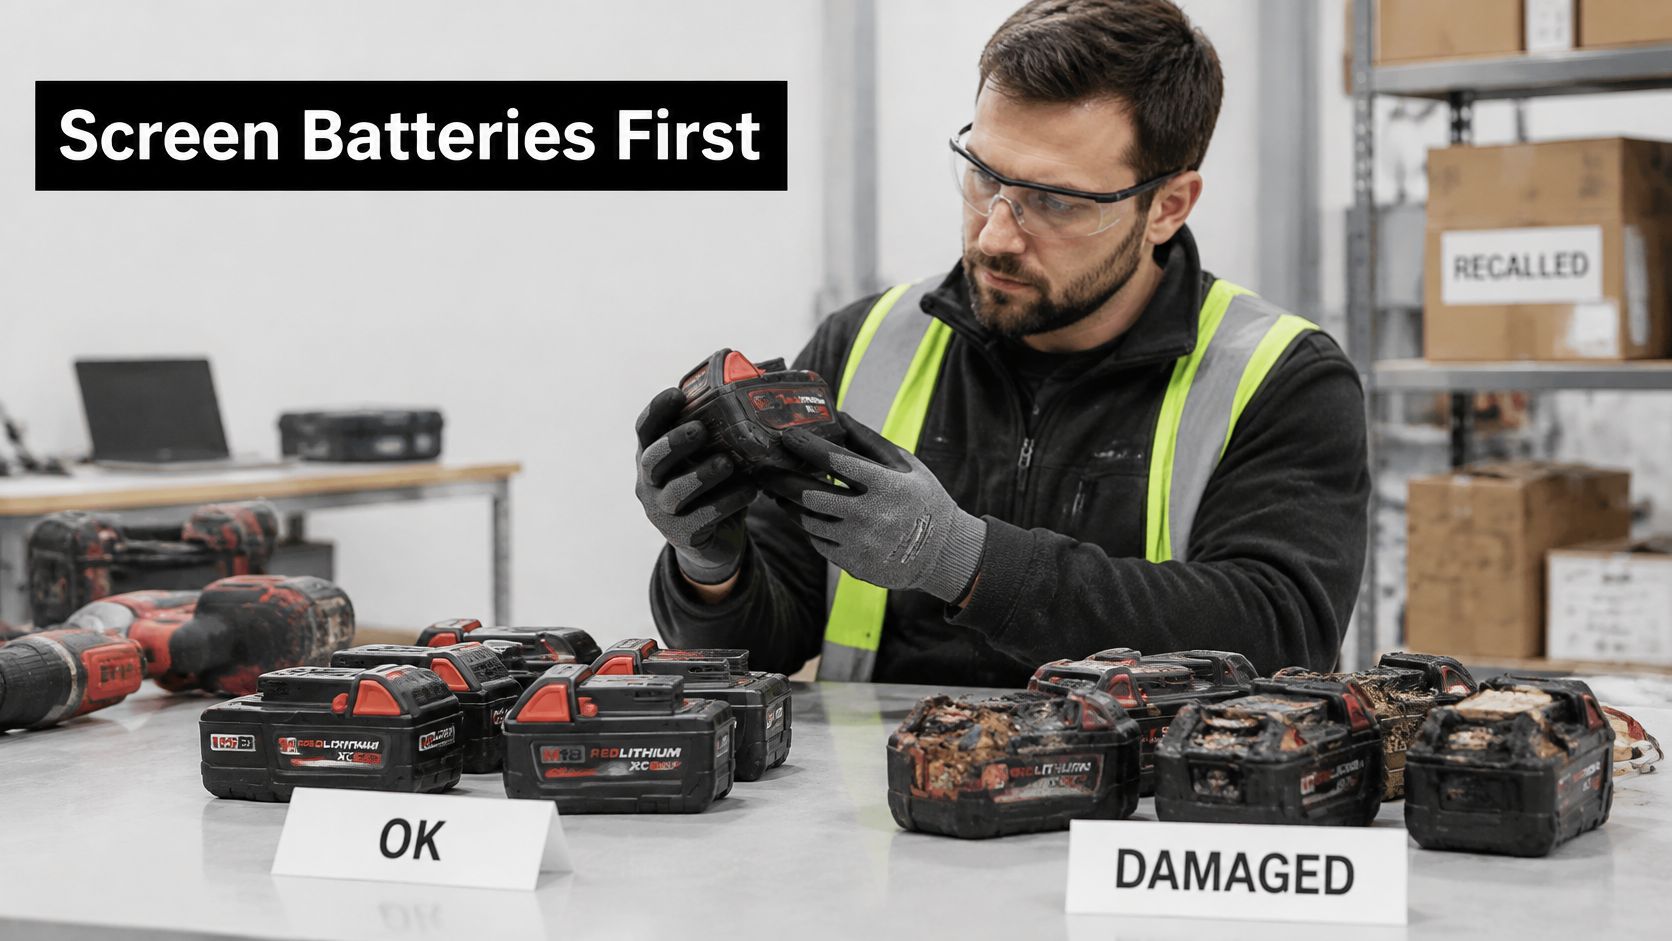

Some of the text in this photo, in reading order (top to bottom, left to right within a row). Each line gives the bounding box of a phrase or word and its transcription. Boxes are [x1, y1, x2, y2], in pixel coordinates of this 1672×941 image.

[1454, 250, 1590, 282] RECALLED
[590, 747, 682, 759] REDLITHIUM
[380, 818, 445, 861] OK
[1116, 849, 1355, 896] DAMAGED
